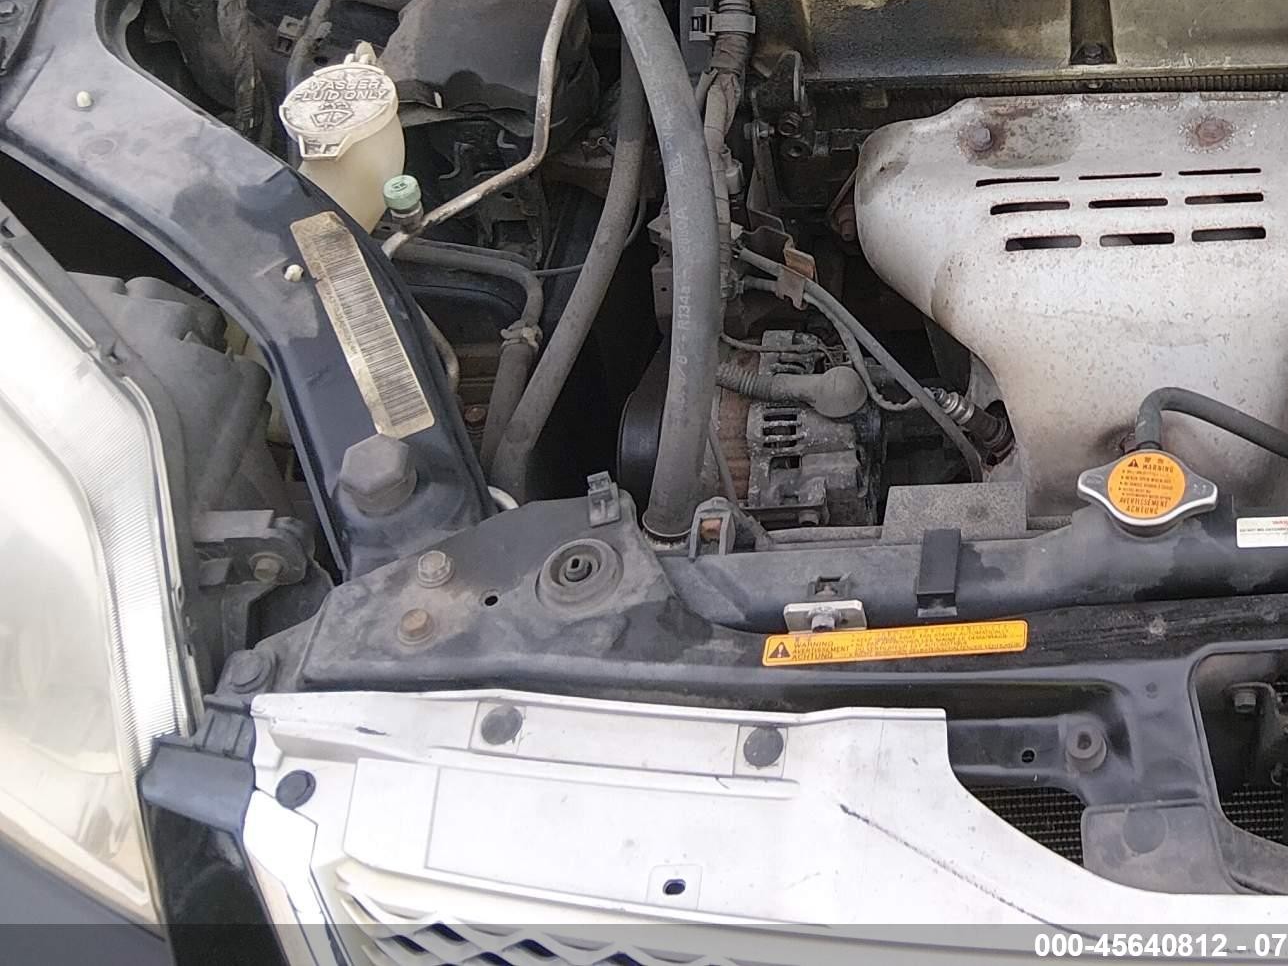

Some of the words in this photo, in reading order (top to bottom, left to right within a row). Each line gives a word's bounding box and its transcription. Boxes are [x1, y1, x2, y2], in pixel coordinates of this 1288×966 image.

[296, 89, 339, 101] FLUID
[344, 89, 388, 100] ONLY
[1142, 464, 1174, 473] WARNING
[793, 641, 834, 649] WARNING
